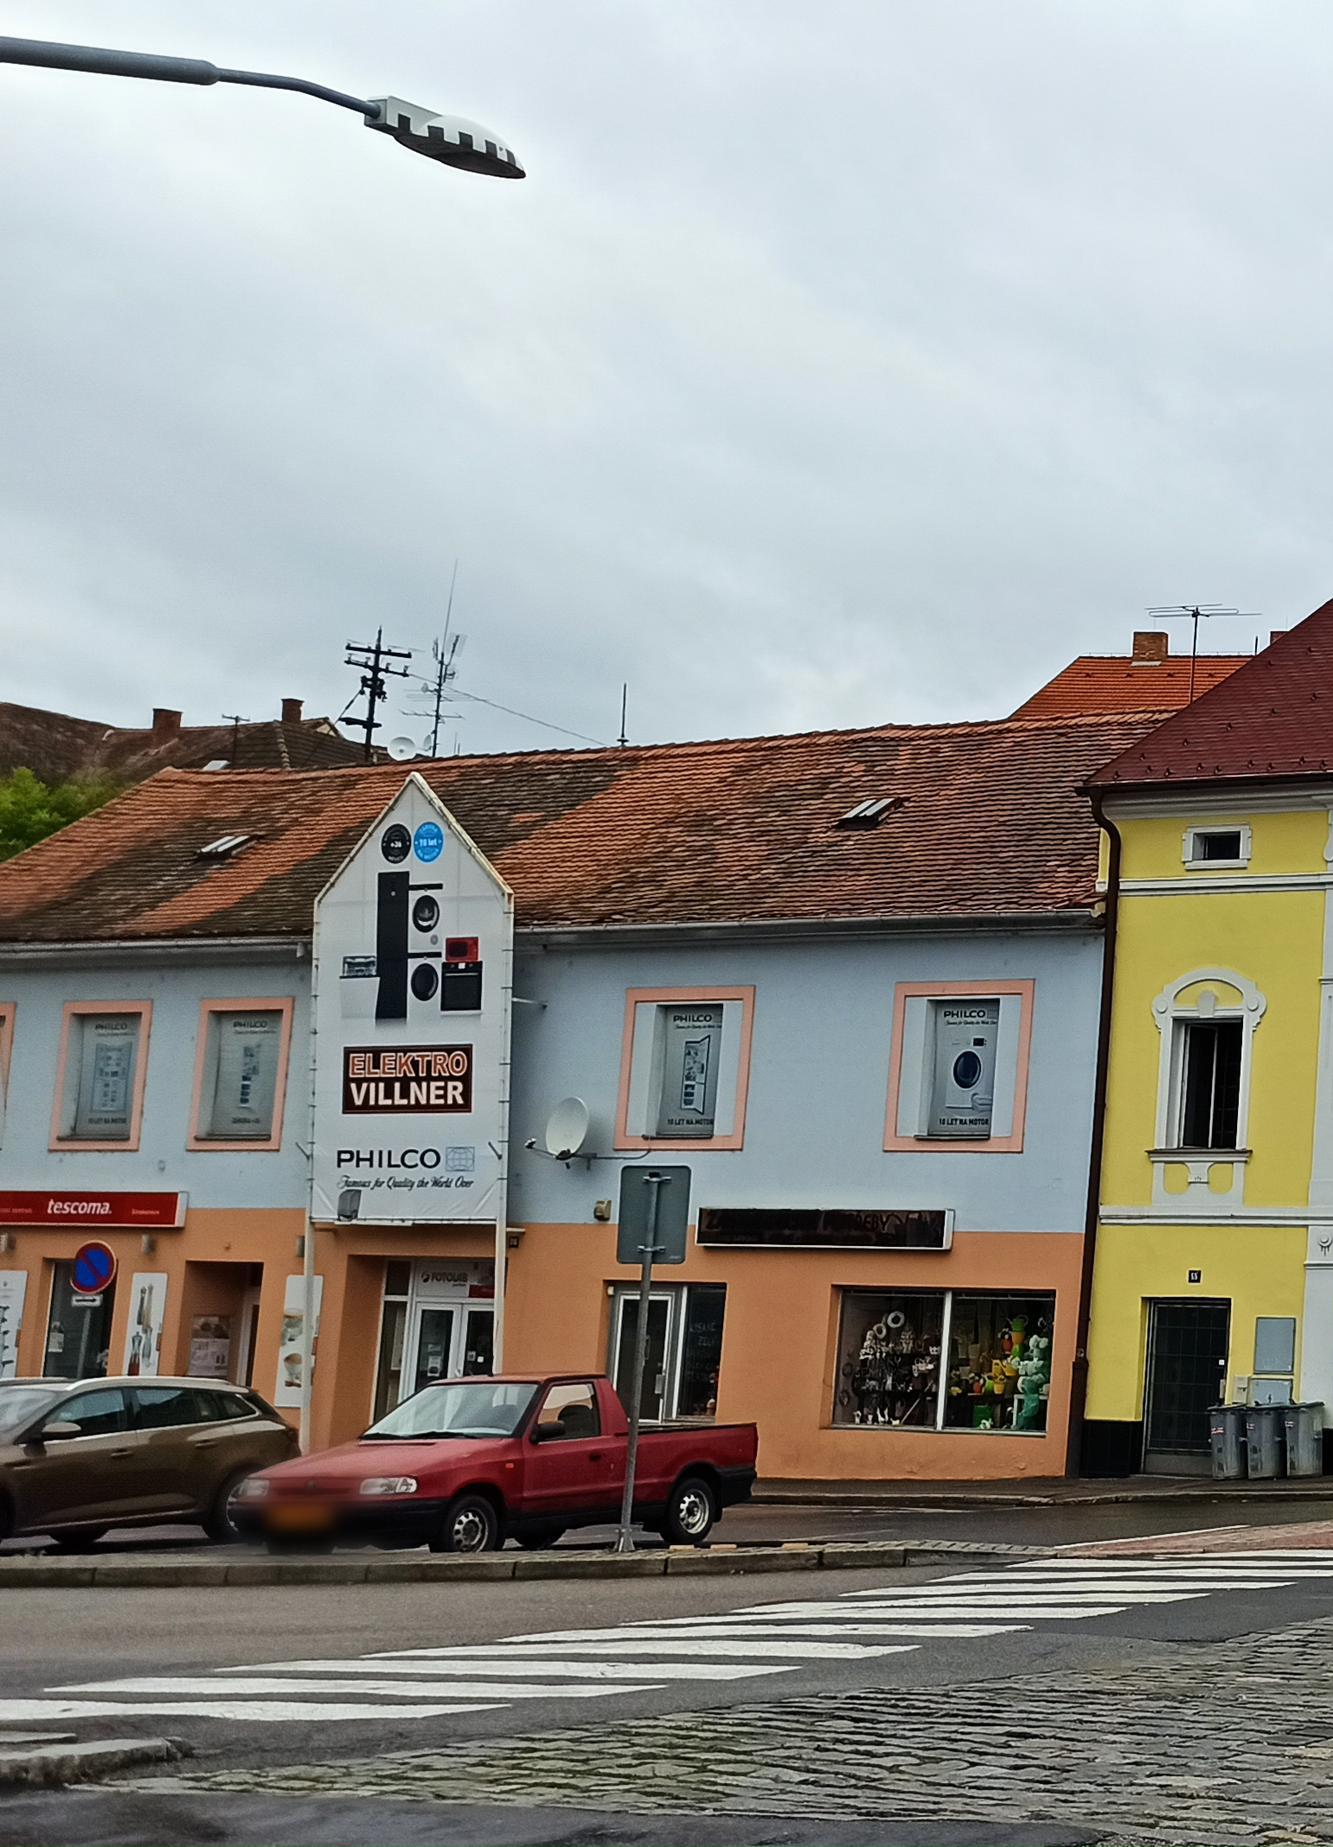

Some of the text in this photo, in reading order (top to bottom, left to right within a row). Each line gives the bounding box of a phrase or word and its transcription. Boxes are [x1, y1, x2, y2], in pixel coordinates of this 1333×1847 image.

[673, 1014, 713, 1022] PHILCO
[943, 1010, 986, 1018] PHILCO
[349, 1051, 468, 1078] ELEKTRO
[350, 1081, 464, 1106] VILLNER
[337, 1149, 441, 1168] PHILCO
